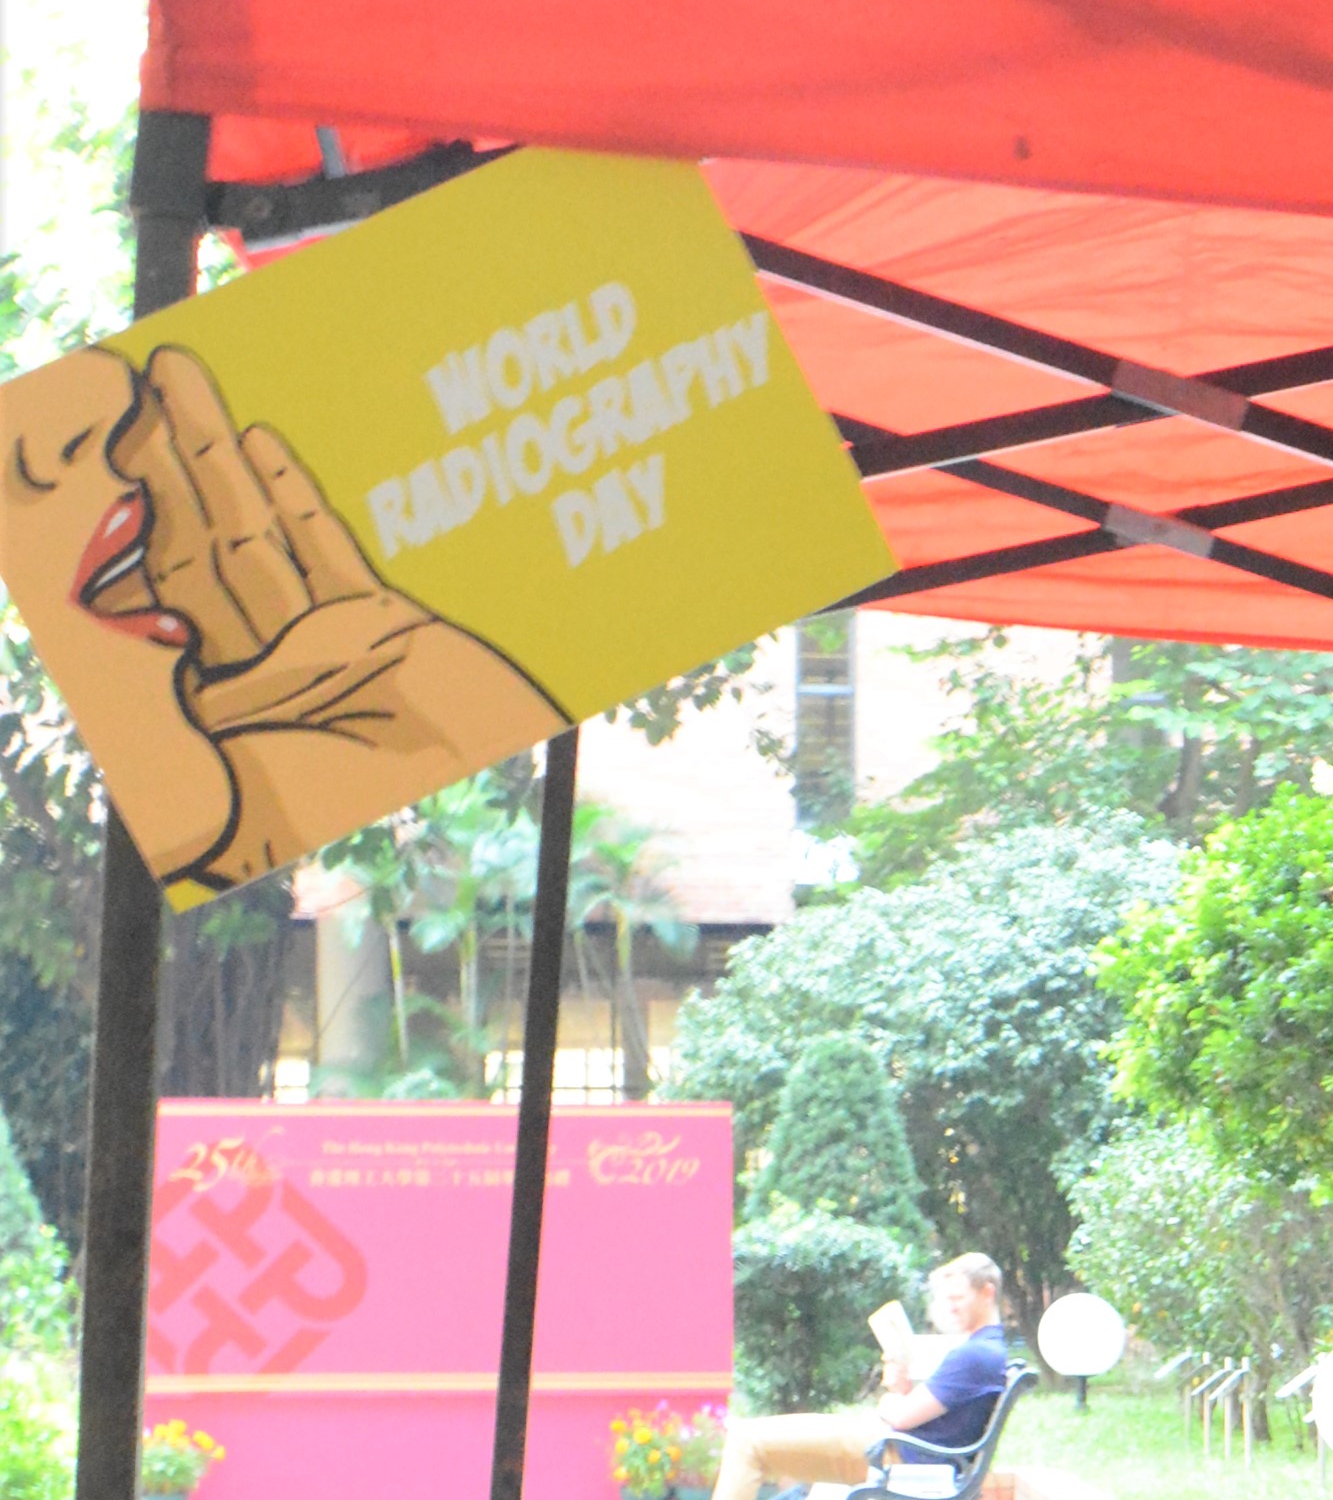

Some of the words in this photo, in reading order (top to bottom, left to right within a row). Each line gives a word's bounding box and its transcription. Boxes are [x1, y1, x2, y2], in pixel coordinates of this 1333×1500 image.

[366, 311, 769, 561] RADIOGRAPHY
[423, 282, 638, 438] WORLD
[551, 453, 666, 569] DAY
